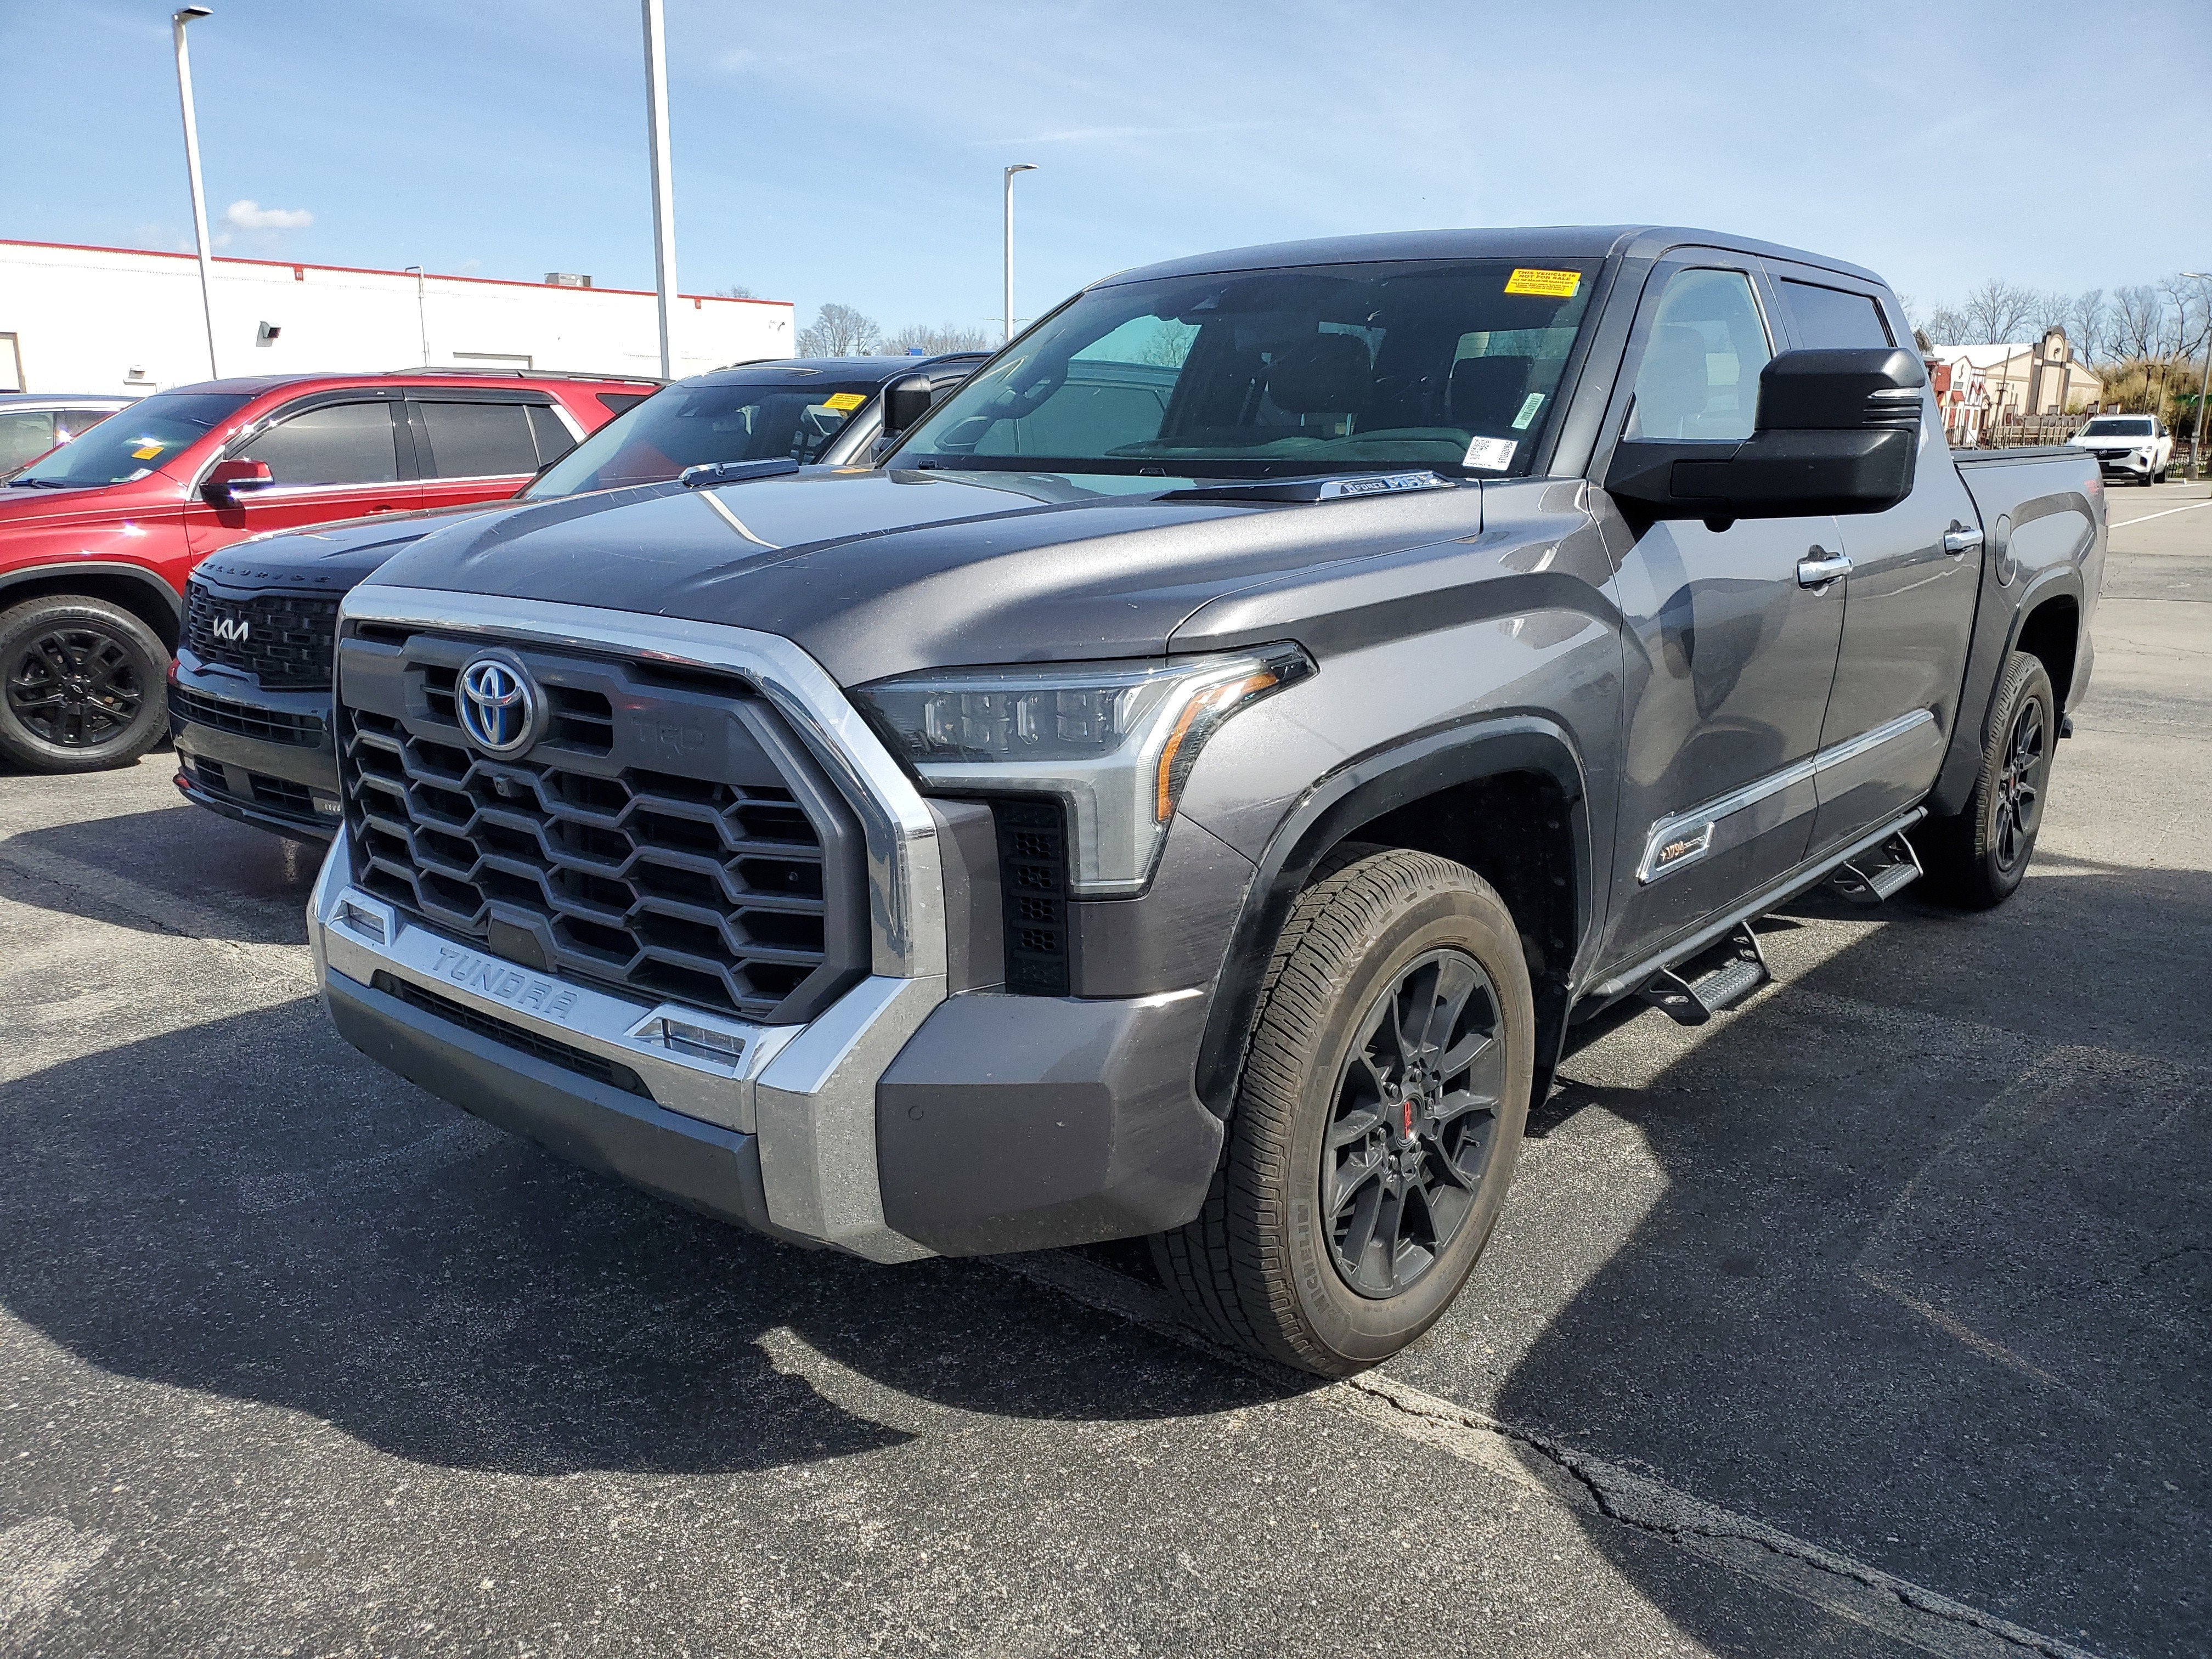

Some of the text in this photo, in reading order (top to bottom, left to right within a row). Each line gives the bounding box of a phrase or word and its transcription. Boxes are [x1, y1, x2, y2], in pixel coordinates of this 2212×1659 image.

[631, 715, 706, 755] TRD
[1665, 840, 1685, 860] 1794
[432, 946, 578, 1019] TUNDRA
[1297, 1205, 1329, 1315] MICHELIN
